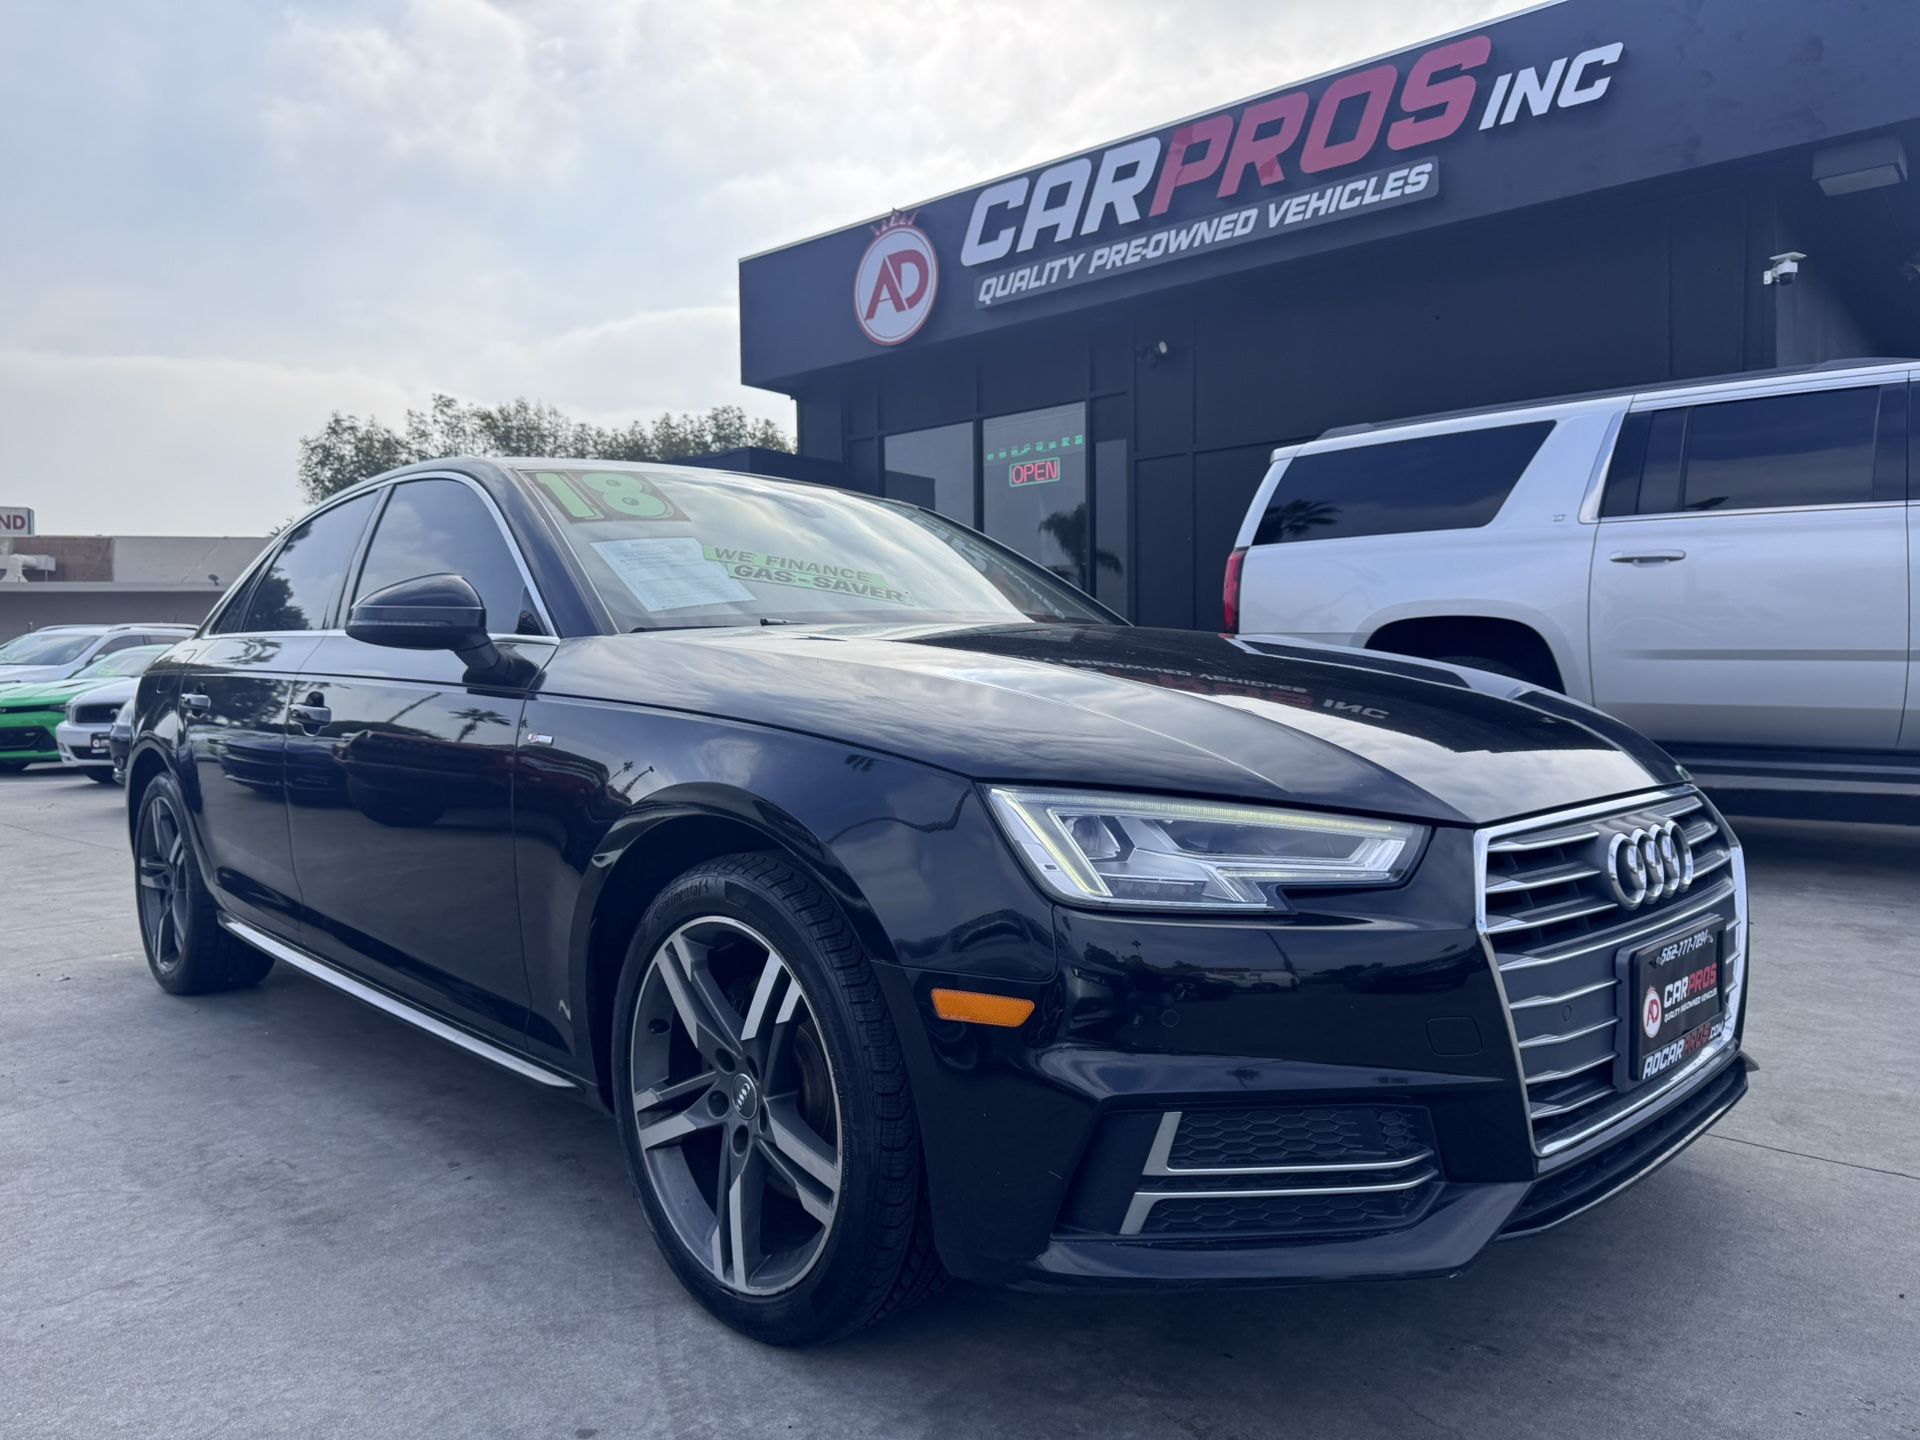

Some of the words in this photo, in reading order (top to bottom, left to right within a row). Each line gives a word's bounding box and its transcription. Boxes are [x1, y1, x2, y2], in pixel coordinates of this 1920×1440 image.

[960, 35, 1492, 267] CARPROS
[1478, 41, 1624, 131] INC
[977, 253, 1085, 304] QUALITY
[1267, 162, 1434, 229] VEHICLES
[864, 249, 930, 320] AD
[535, 472, 673, 519] 18
[1012, 461, 1058, 484] OPEN
[714, 547, 753, 563] WE
[765, 556, 873, 583] FINANCE
[1664, 962, 1718, 1009] CARPROS
